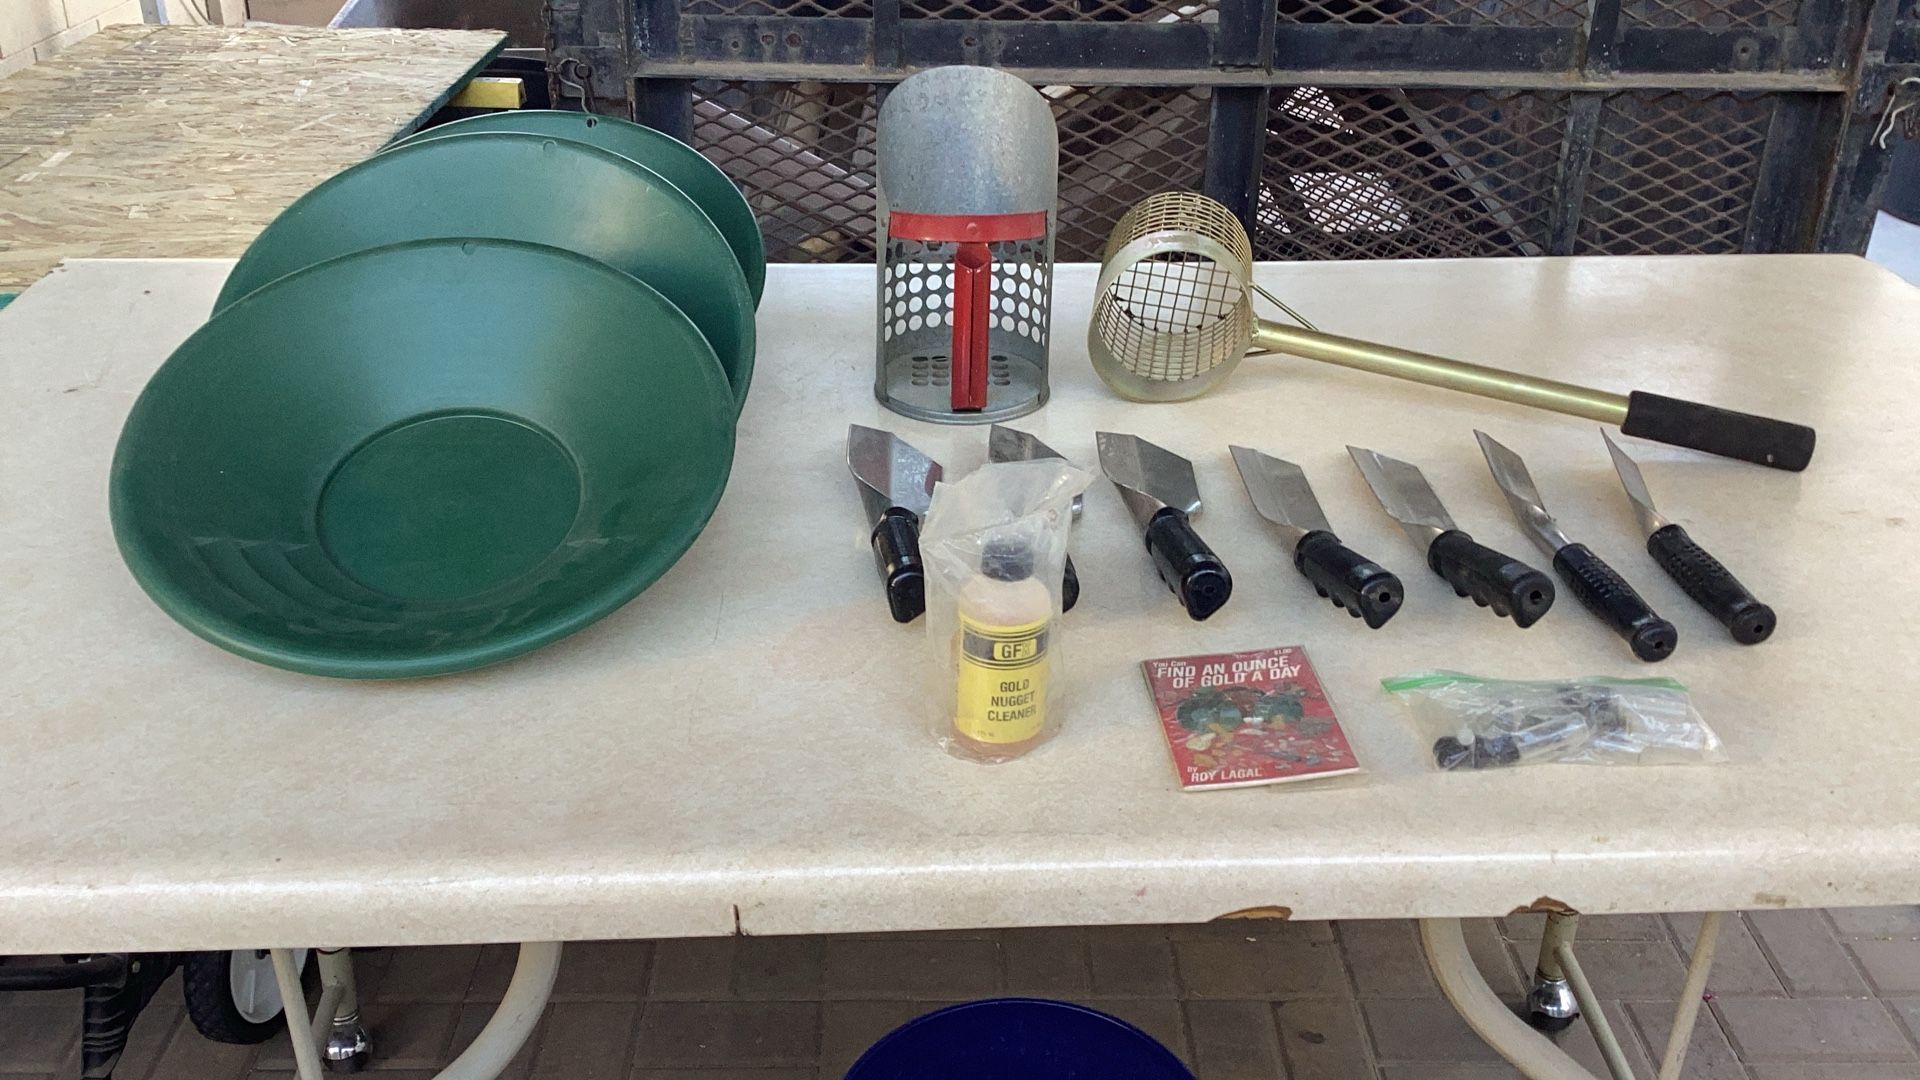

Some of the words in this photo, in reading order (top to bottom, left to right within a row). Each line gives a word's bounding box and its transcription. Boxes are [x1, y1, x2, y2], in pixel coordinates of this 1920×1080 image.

[1157, 665, 1196, 678] FIND
[1202, 663, 1225, 676] AN
[1232, 655, 1289, 673] OUNCE
[1172, 677, 1195, 689] OF
[1201, 672, 1246, 688] GOLD
[1251, 671, 1263, 682] A
[1270, 664, 1301, 680] DAY
[1000, 678, 1030, 693] GOLD
[991, 690, 1035, 707] NUGGET
[988, 704, 1037, 722] CLEANER
[1191, 770, 1217, 783] ROY
[1221, 767, 1263, 780] LAGAL
